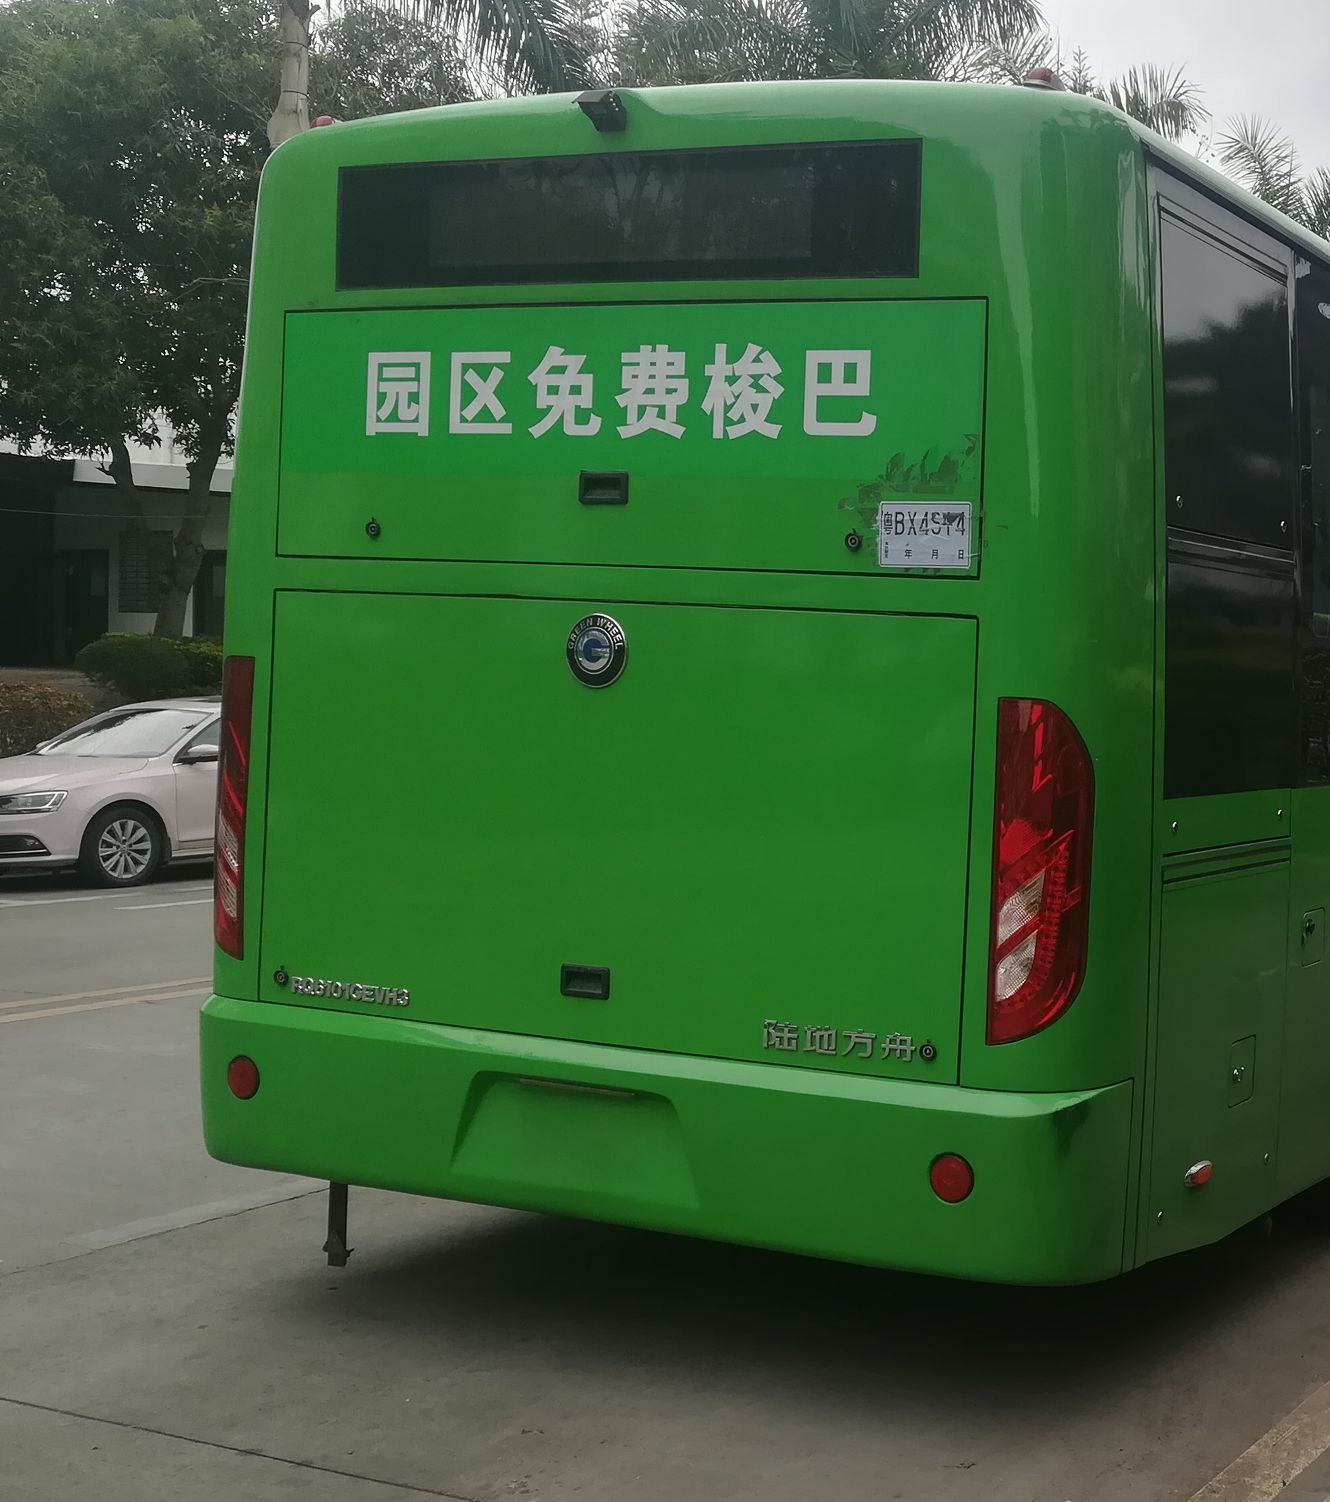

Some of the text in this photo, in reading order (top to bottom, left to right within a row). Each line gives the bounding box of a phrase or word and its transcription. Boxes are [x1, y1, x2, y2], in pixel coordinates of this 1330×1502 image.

[365, 343, 877, 440] 园区免费梭巴
[904, 548, 913, 559] 年
[931, 548, 939, 559] 月
[762, 1018, 916, 1062] 陆地方舟
